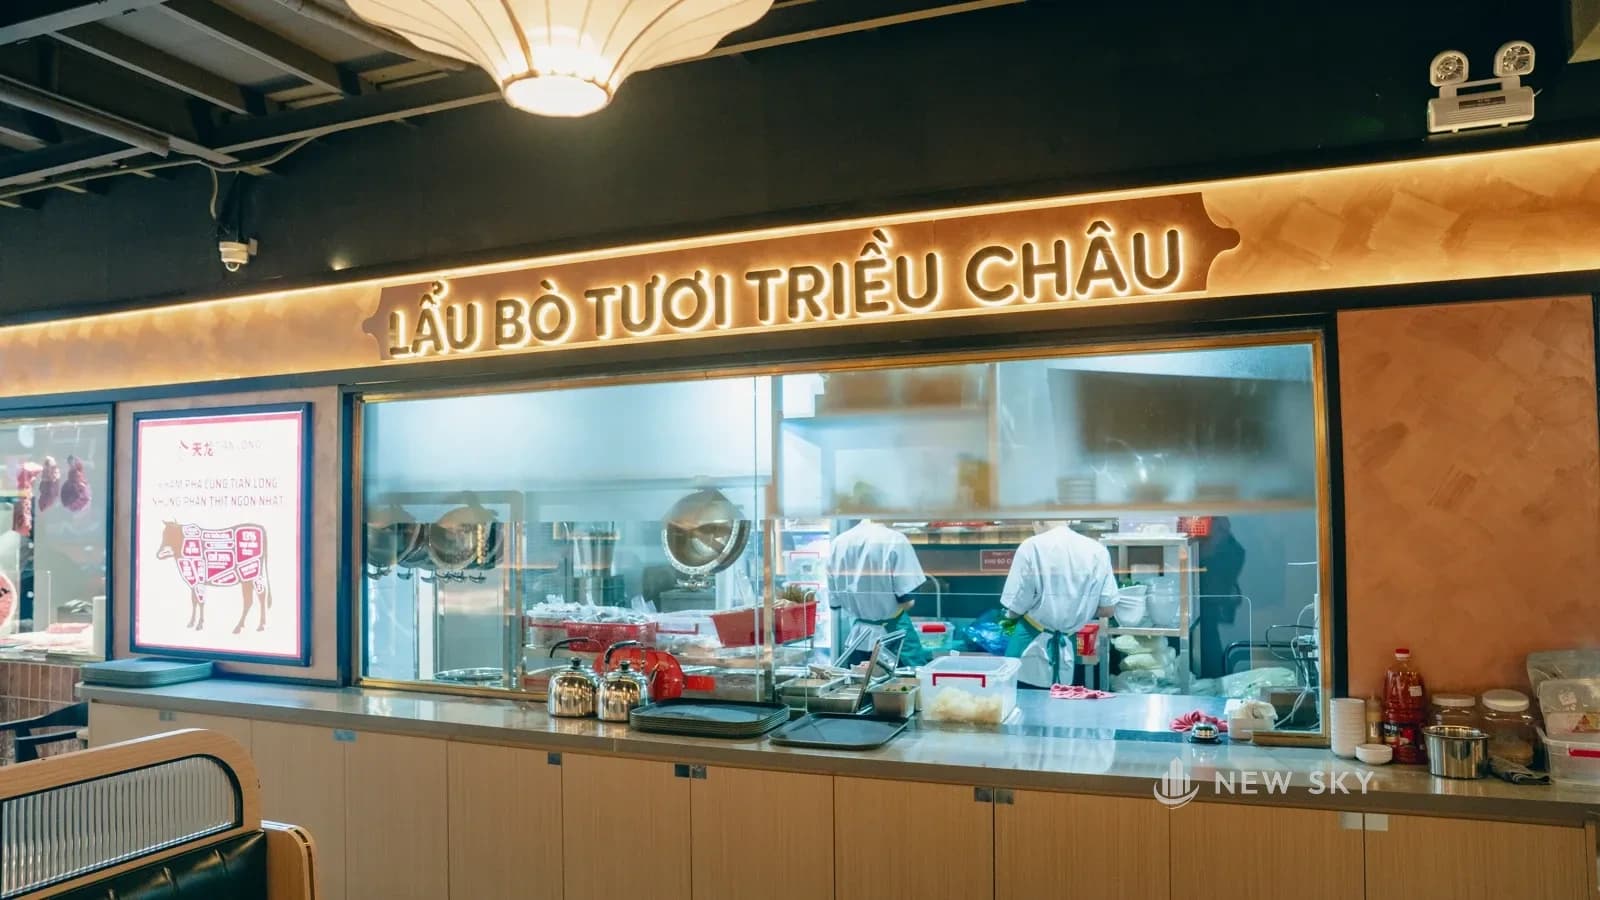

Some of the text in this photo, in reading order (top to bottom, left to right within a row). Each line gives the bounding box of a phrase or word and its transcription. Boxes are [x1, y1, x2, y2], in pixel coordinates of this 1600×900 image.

[388, 219, 1184, 358] LẨU BÒ TƯƠI TRIỀU CHÂU
